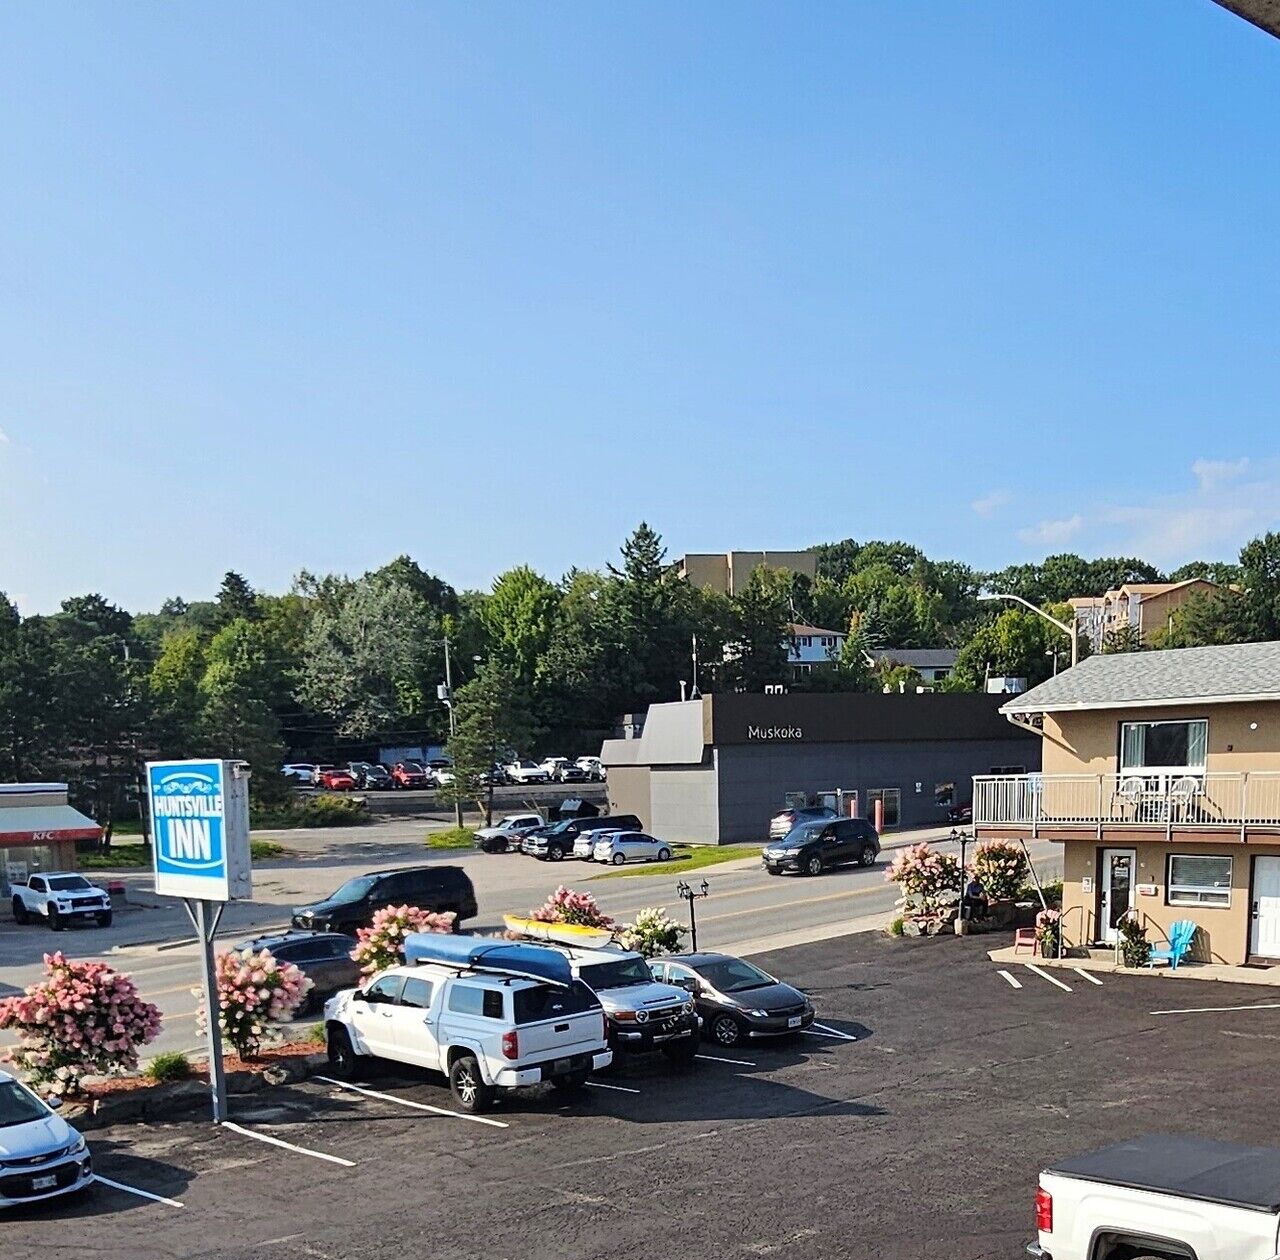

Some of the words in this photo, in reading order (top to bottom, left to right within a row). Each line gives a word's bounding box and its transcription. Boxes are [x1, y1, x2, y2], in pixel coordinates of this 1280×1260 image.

[748, 725, 802, 739] Muskoka
[154, 795, 222, 817] HUNTSVILLE
[32, 832, 55, 841] KFC
[168, 819, 211, 860] INN
